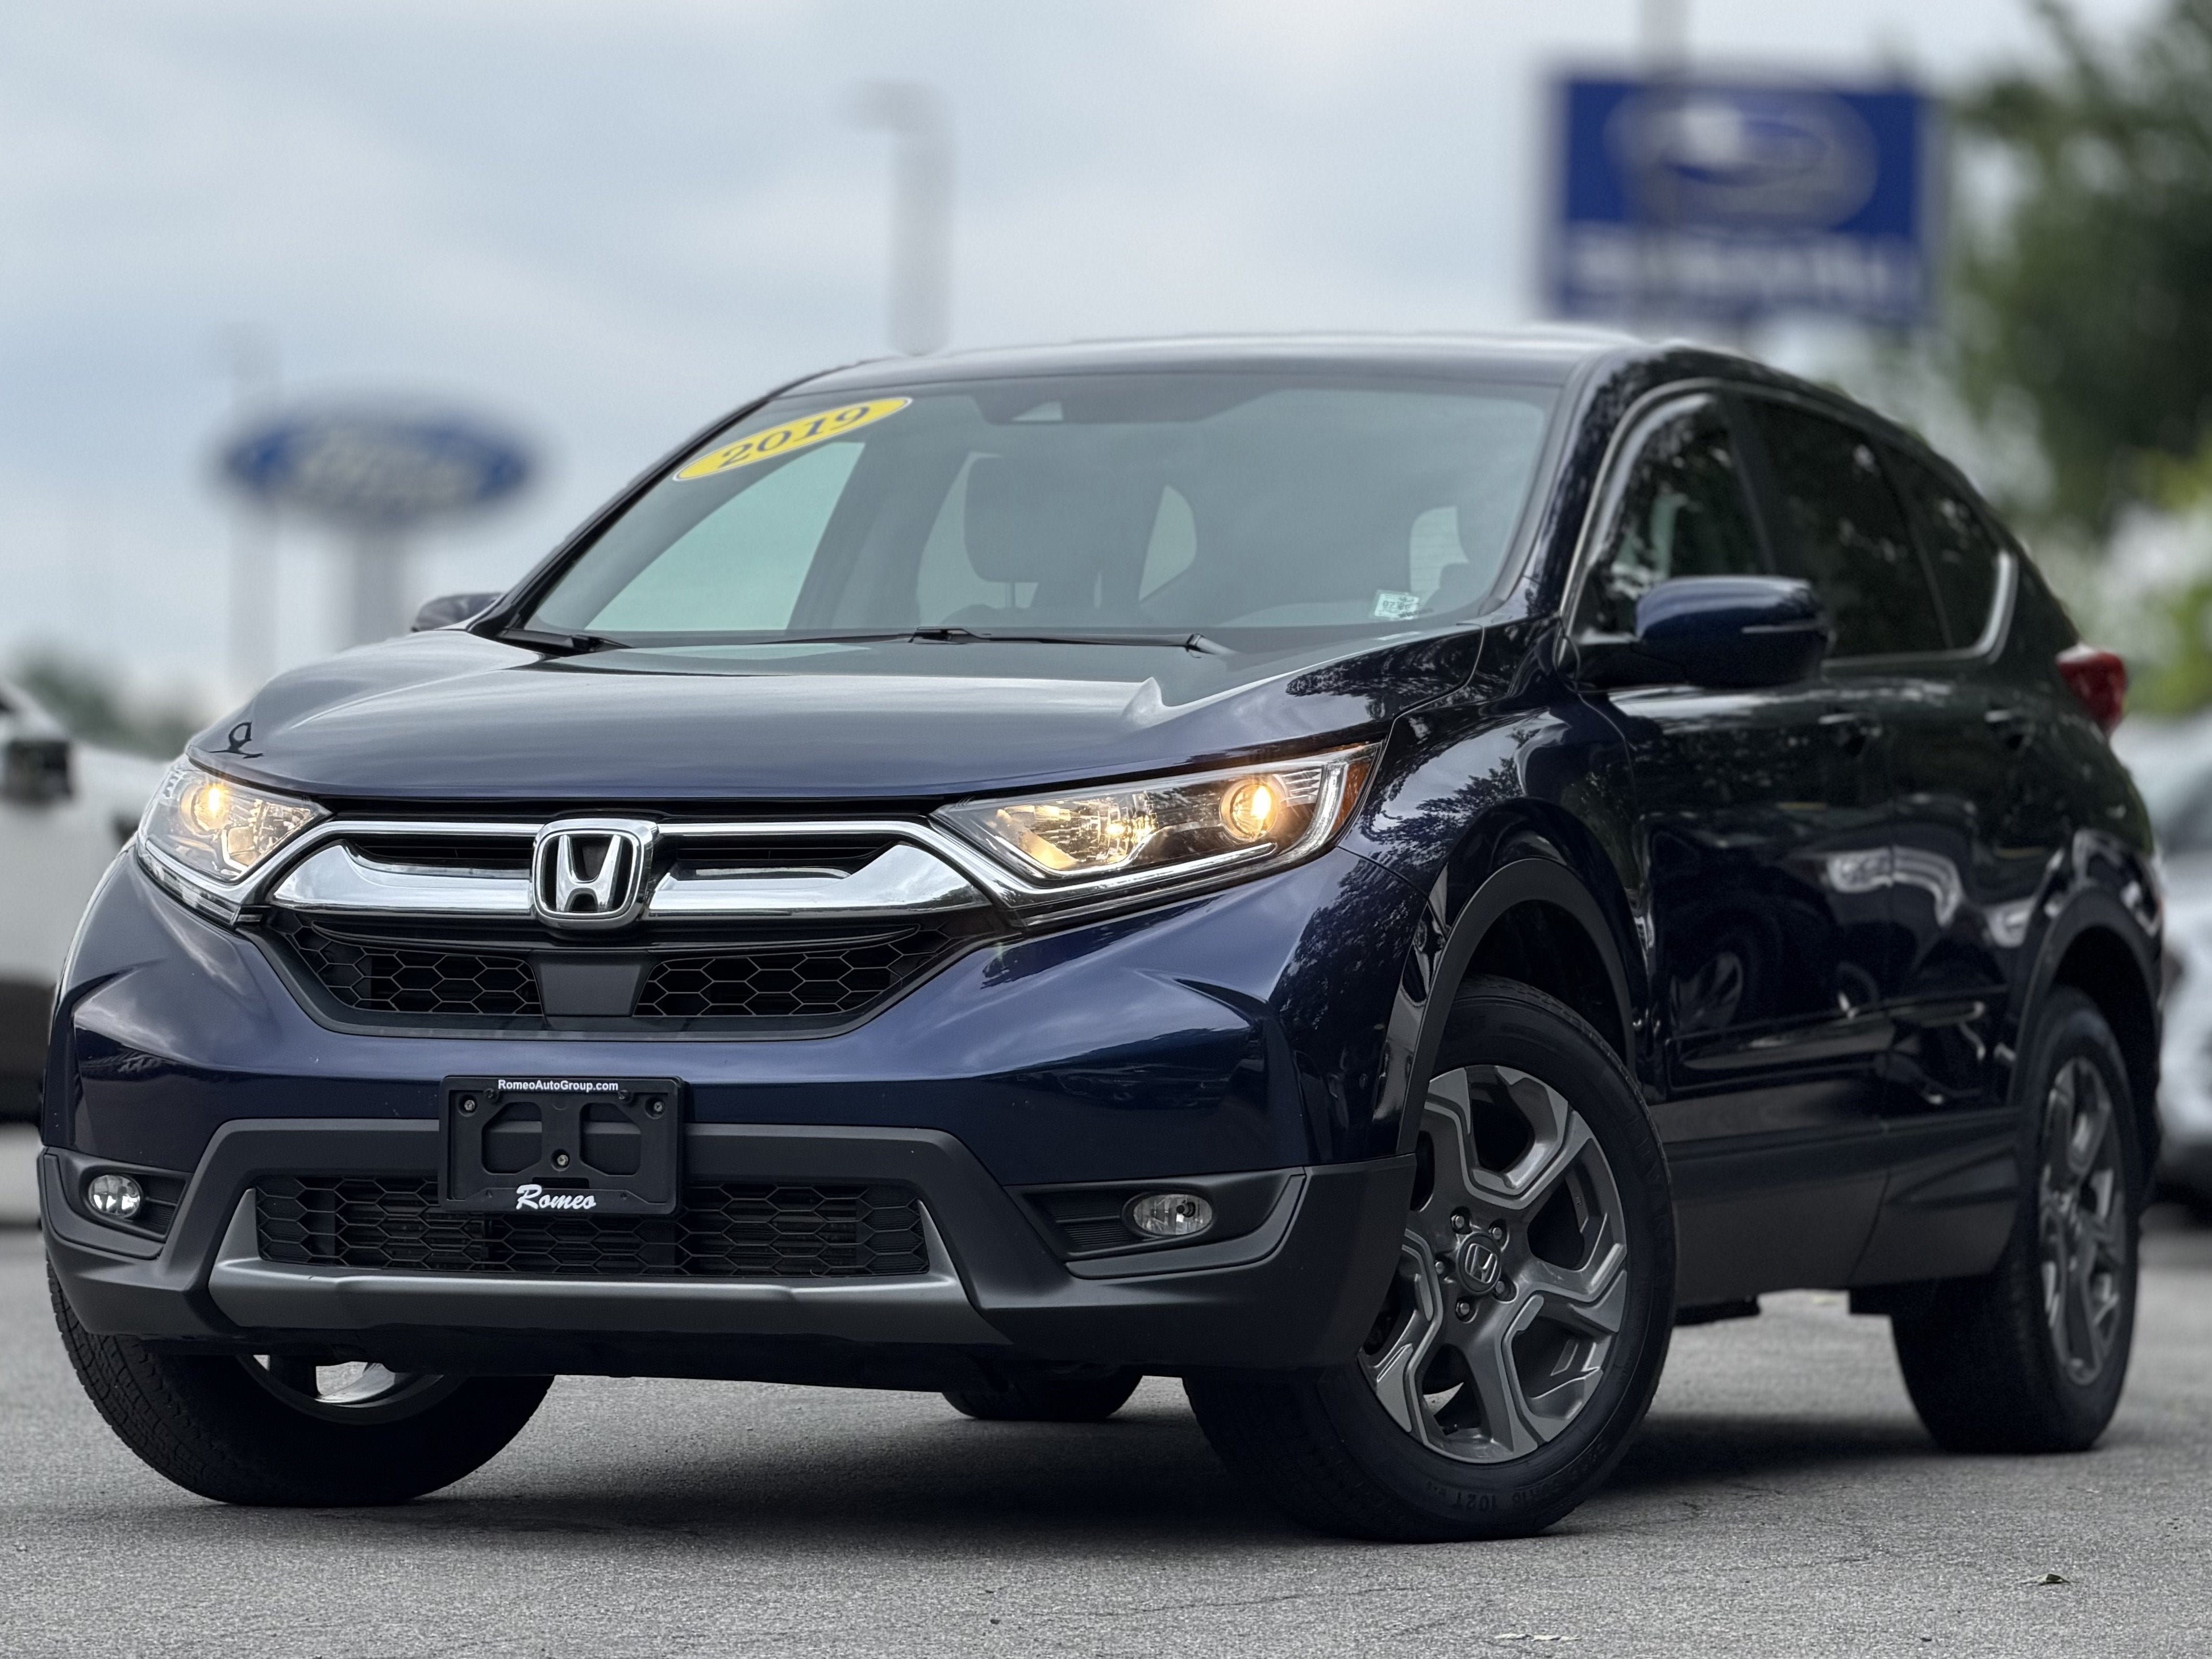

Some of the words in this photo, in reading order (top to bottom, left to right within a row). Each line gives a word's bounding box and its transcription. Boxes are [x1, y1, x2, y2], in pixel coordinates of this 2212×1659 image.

[717, 406, 870, 469] 2019
[498, 1079, 619, 1093] RomeoAutoGroup.com
[515, 1184, 597, 1210] Romeo
